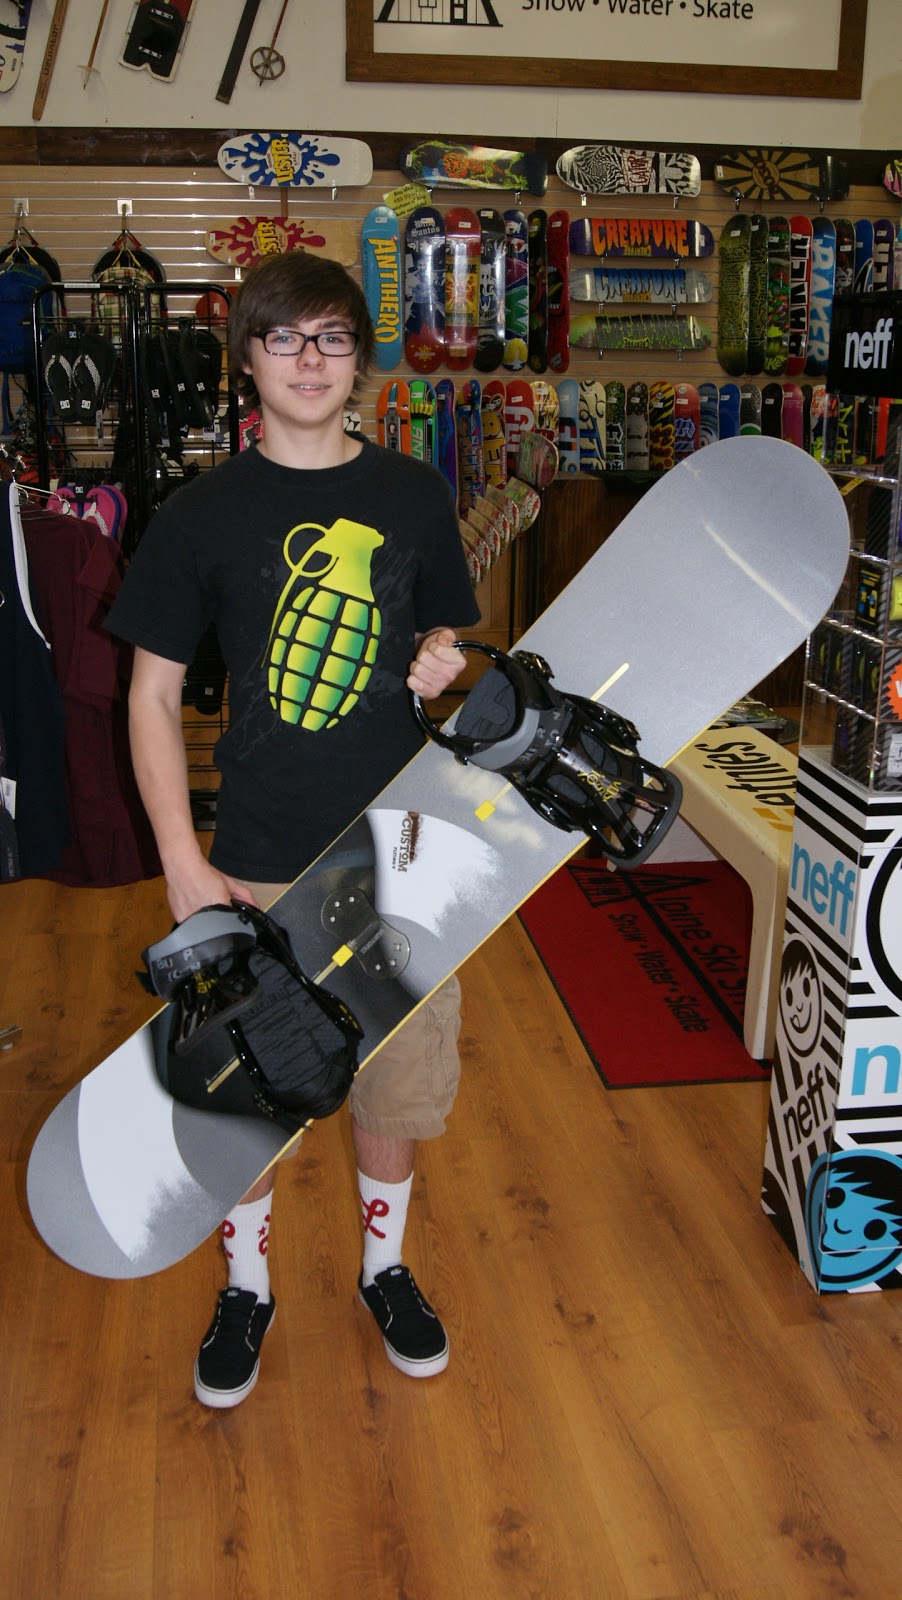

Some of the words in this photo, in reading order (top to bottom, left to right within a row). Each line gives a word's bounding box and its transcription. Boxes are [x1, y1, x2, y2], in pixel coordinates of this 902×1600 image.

[609, 0, 673, 16] Water
[692, 0, 754, 19] Skate
[270, 138, 295, 183] LESTER
[411, 226, 440, 237] Santos
[592, 218, 689, 256] CREATURE
[594, 268, 688, 303] CREATURE
[807, 244, 834, 362] BAKER
[844, 317, 894, 370] neff
[398, 818, 412, 873] CUSTOM
[790, 841, 857, 937] neff
[608, 913, 643, 943] Snow
[635, 949, 675, 986] Water
[664, 994, 710, 1033] Skate
[782, 1062, 826, 1154] neff
